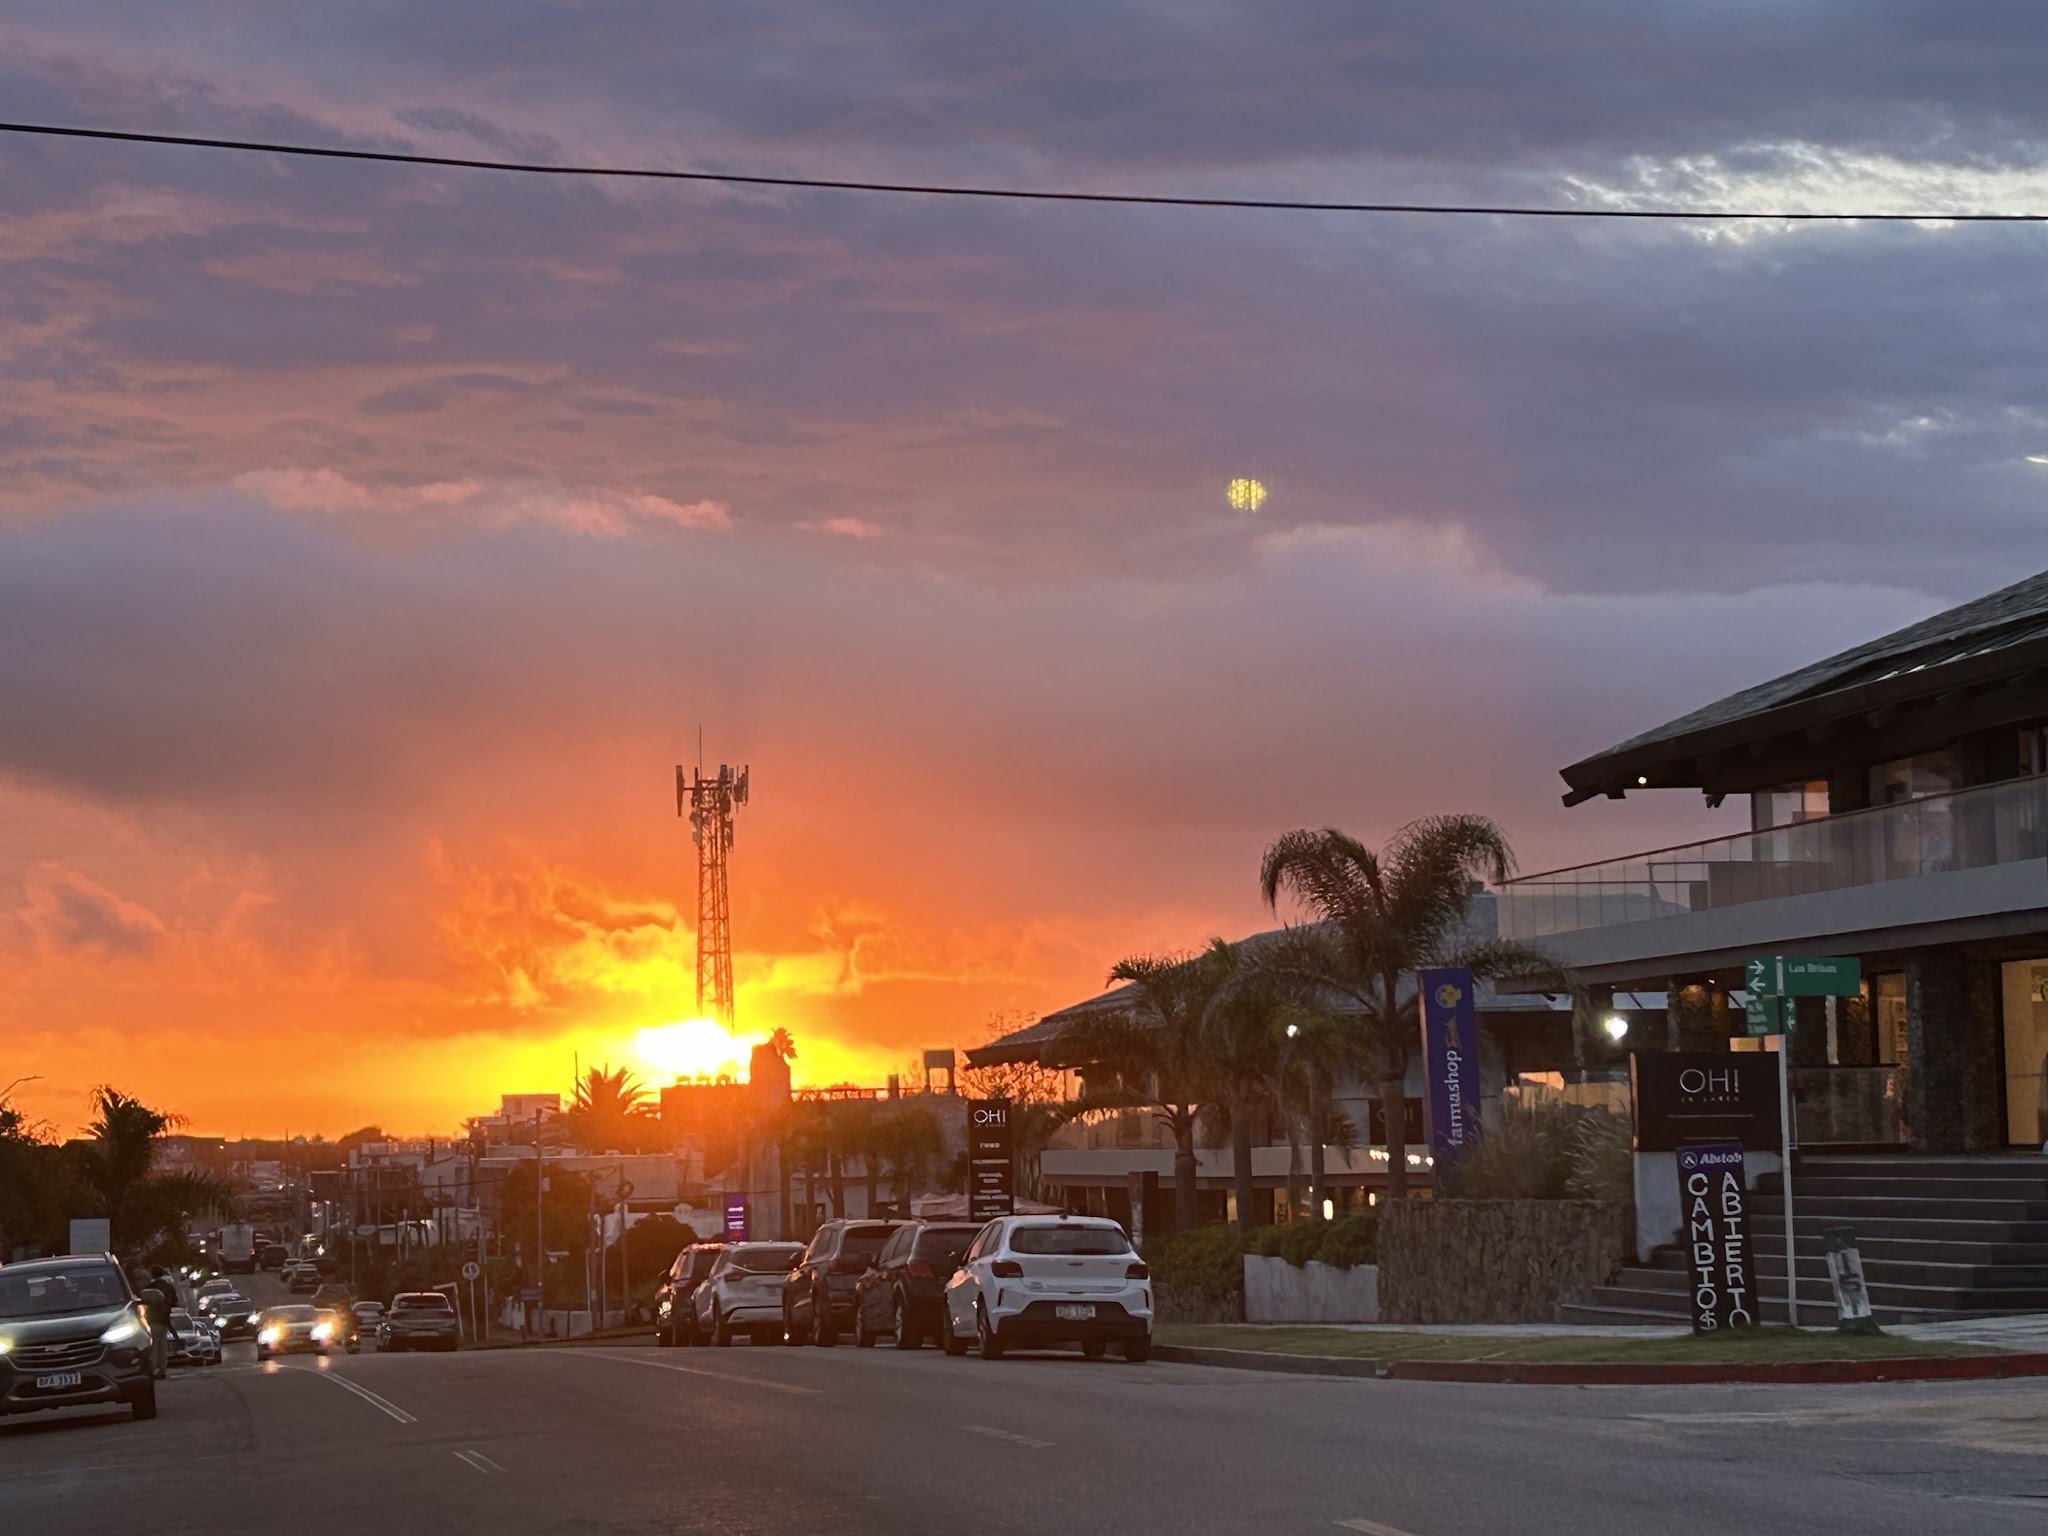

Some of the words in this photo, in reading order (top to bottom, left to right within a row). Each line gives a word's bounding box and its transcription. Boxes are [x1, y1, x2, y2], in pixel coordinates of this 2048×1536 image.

[1444, 1049, 1463, 1147] farmashop
[1680, 1068, 1739, 1093] OH!
[1721, 1171, 1751, 1329] ABIERTO
